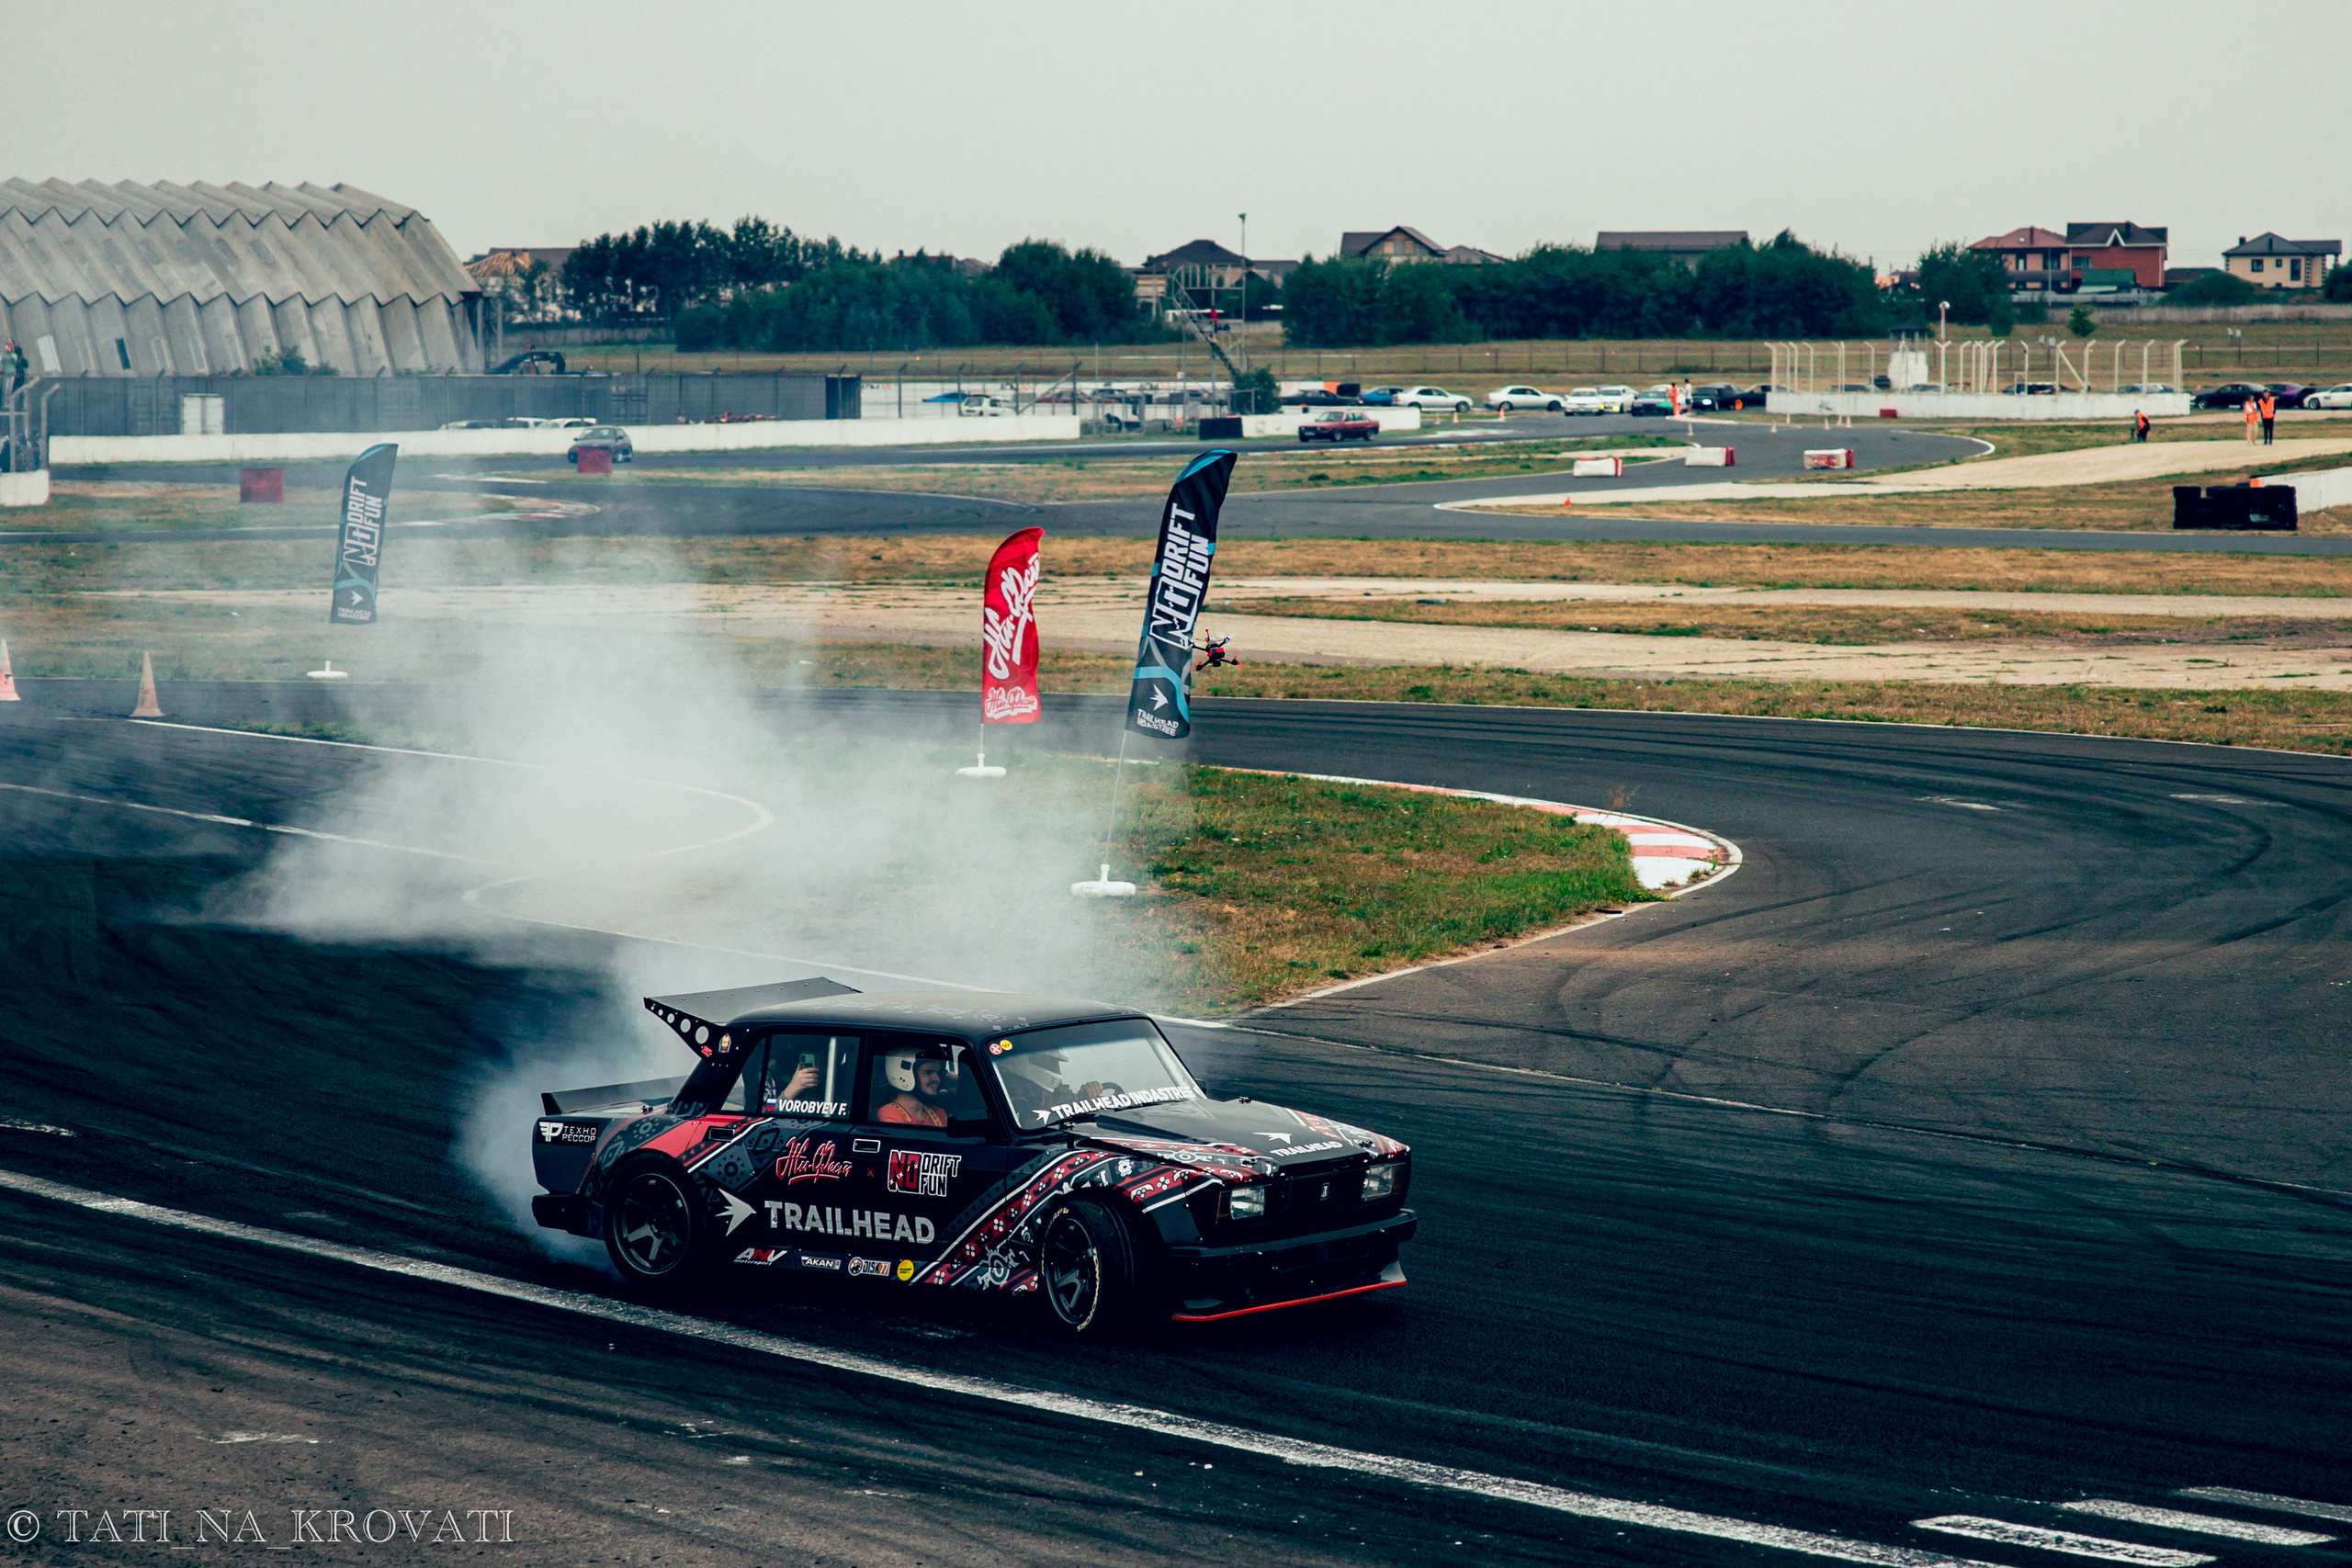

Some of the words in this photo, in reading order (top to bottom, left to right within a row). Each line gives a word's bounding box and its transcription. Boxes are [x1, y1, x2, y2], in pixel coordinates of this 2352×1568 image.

[346, 475, 368, 525] DRIFT
[363, 495, 382, 528] FUN
[343, 522, 379, 567] NO
[1160, 502, 1195, 581] DRIFT
[1182, 534, 1209, 589] FUN
[1148, 576, 1201, 650] NO
[1137, 708, 1179, 728] TRAILHEAD
[778, 1099, 838, 1115] VOROBYEV
[838, 1103, 847, 1116] F.
[1051, 1093, 1132, 1119] TRAILHEAD
[1129, 1086, 1195, 1105] INDASTREE
[561, 1134, 596, 1143] РЕССОР
[563, 1125, 597, 1135] ТЕХНО
[1270, 1141, 1343, 1157] TRAILHEAD
[888, 1149, 922, 1194] NO
[921, 1153, 962, 1177] DRIFT
[920, 1174, 947, 1197] FUN
[764, 1201, 935, 1245] TRAILHEAD
